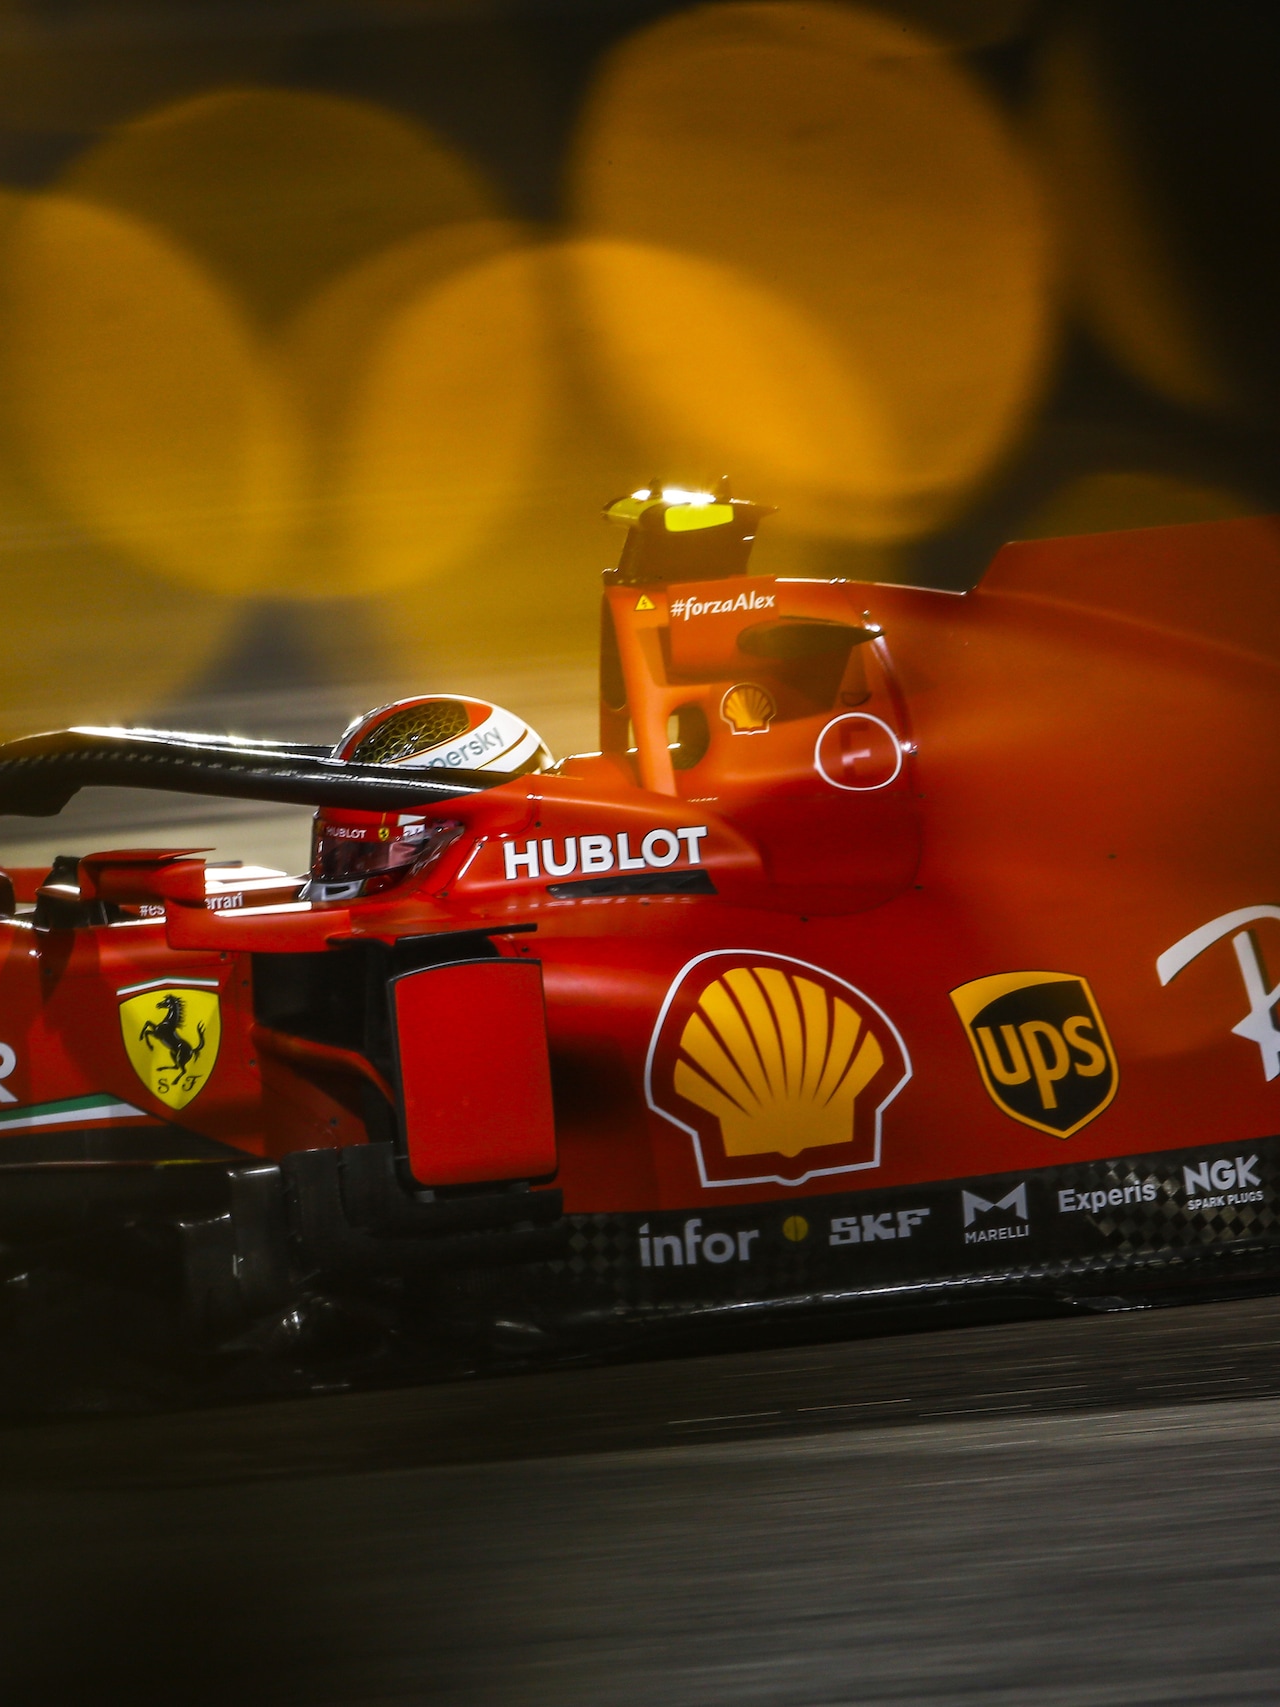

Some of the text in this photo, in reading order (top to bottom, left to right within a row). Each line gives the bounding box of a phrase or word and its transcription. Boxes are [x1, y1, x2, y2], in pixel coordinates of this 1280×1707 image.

[670, 590, 776, 622] #forzaAlex
[504, 826, 708, 880] HUBLOT
[976, 1015, 1107, 1110] ups
[1182, 1153, 1261, 1196] NGK
[1057, 1179, 1158, 1214] Experis
[1187, 1190, 1264, 1211] SPARK PLUGS
[638, 1218, 760, 1267] infor
[828, 1207, 931, 1246] SKF
[964, 1223, 1030, 1244] MARELLI
